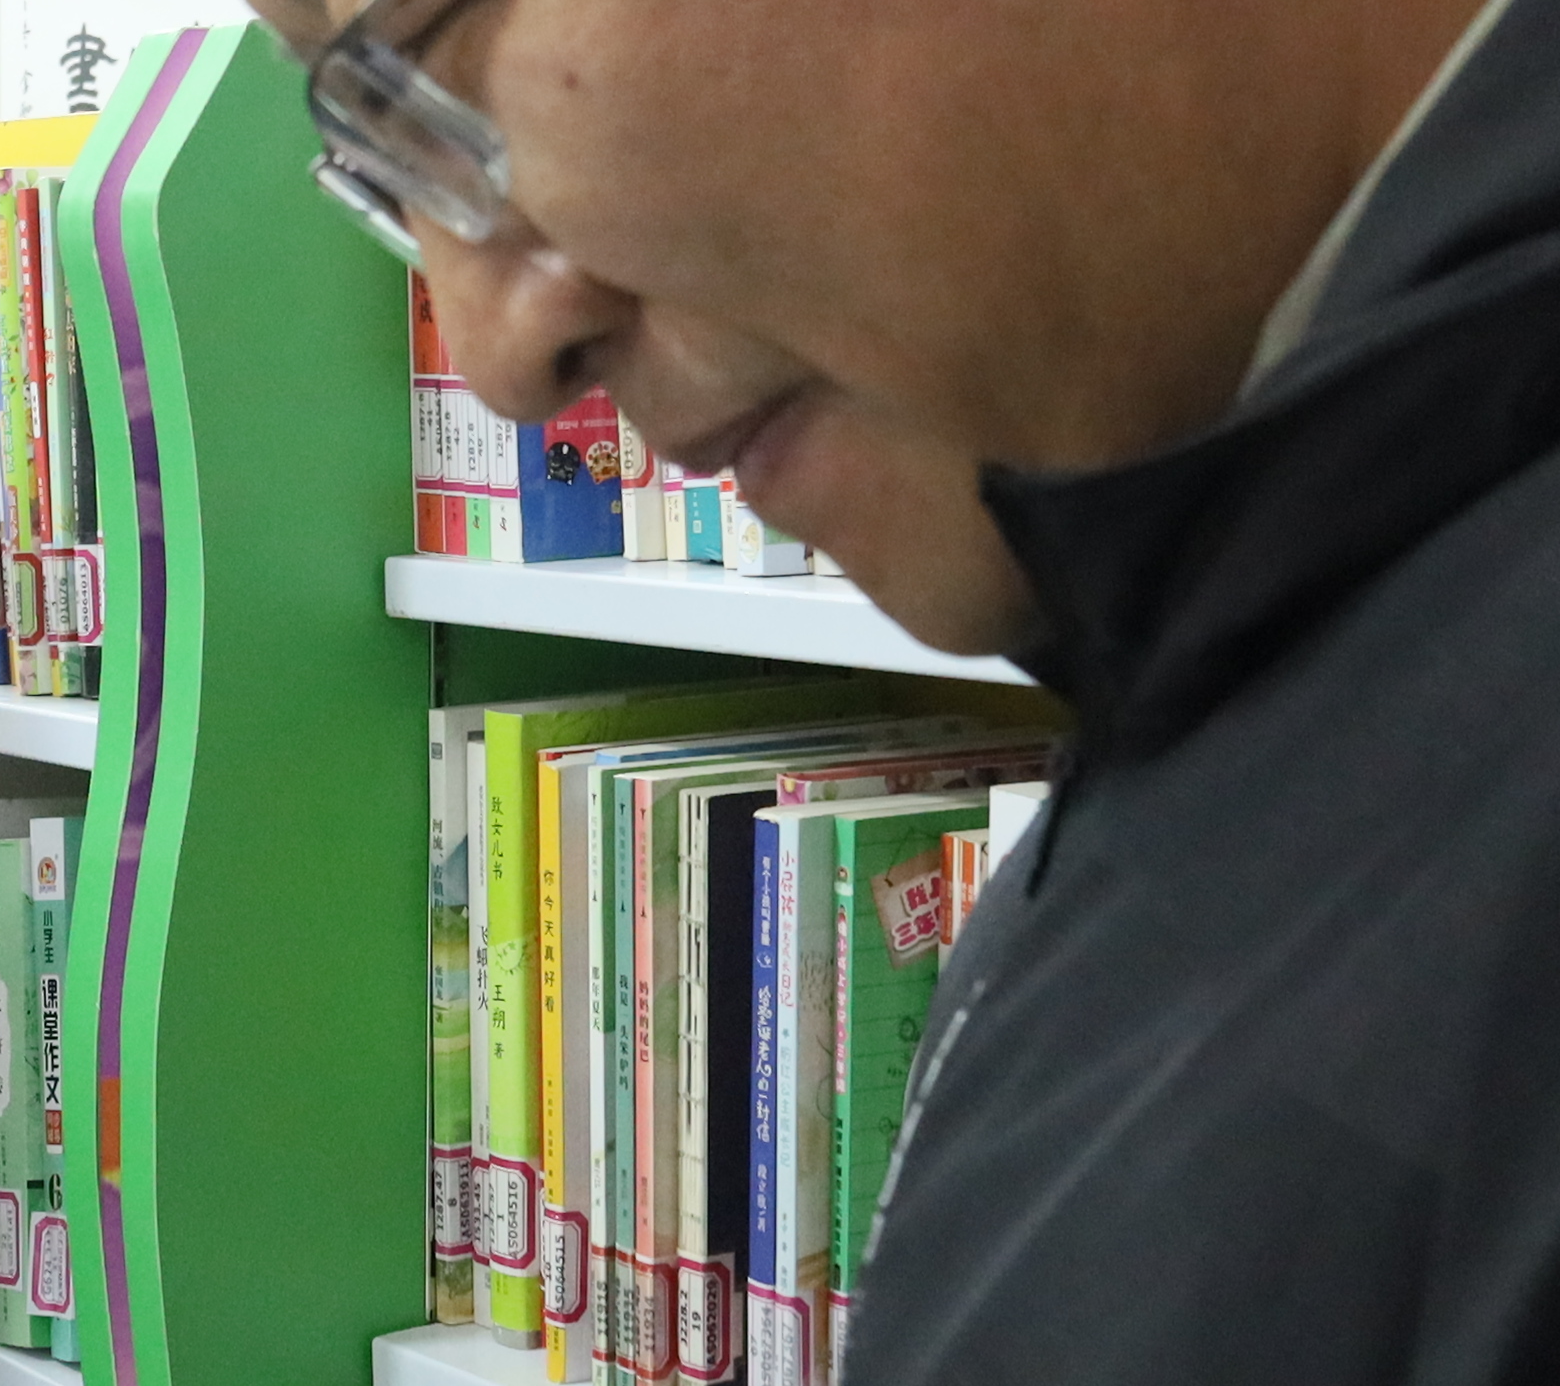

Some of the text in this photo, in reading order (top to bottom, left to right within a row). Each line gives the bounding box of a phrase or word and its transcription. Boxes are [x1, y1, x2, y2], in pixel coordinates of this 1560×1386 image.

[491, 796, 505, 881] 致女儿书
[43, 909, 54, 964] 小学生
[544, 869, 555, 1013] 你今天真好看
[492, 984, 506, 1030] 王朔
[591, 966, 601, 1032] 那年夏天
[638, 979, 650, 1063] 妈妈的尾巴
[41, 978, 60, 1104] 课堂作文
[493, 1042, 505, 1059] 著
[48, 1173, 63, 1211] 6
[508, 1180, 519, 1260] AS064516
[691, 1310, 701, 1332] 19
